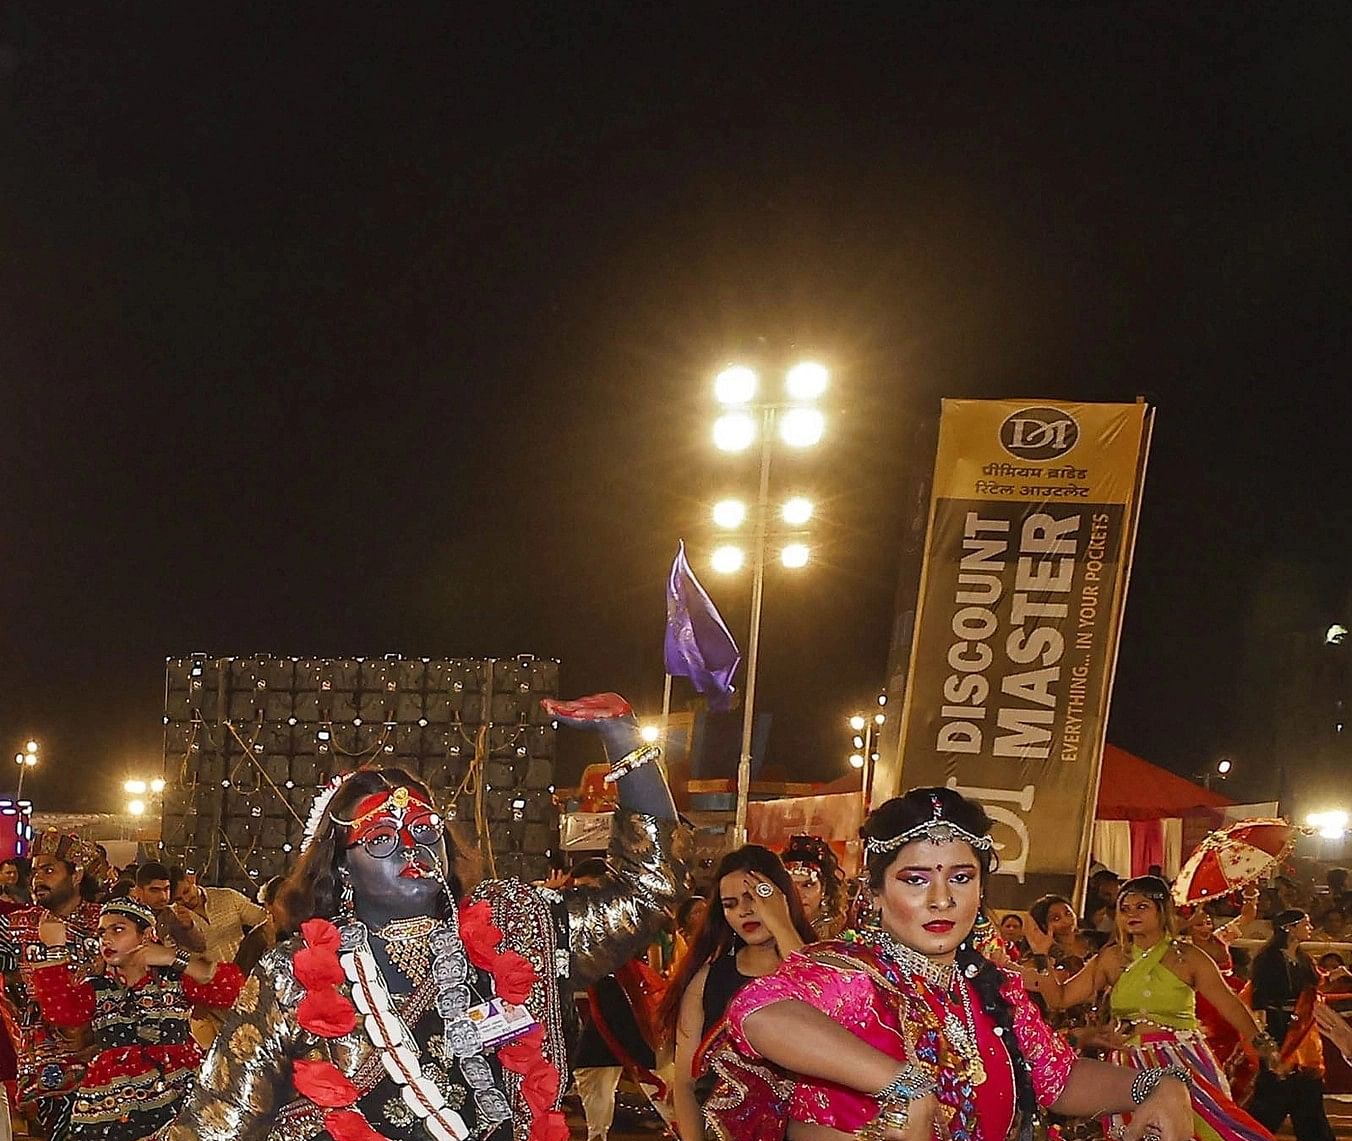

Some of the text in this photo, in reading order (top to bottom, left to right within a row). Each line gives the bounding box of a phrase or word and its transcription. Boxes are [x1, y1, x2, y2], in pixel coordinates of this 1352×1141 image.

[1019, 484, 1090, 497] आउटलेट
[1085, 513, 1110, 582] POCKETS
[936, 512, 1010, 754] DISCOUNT
[993, 513, 1081, 759] MASTER
[1078, 585, 1099, 632] YOUR
[1076, 632, 1093, 650] IN
